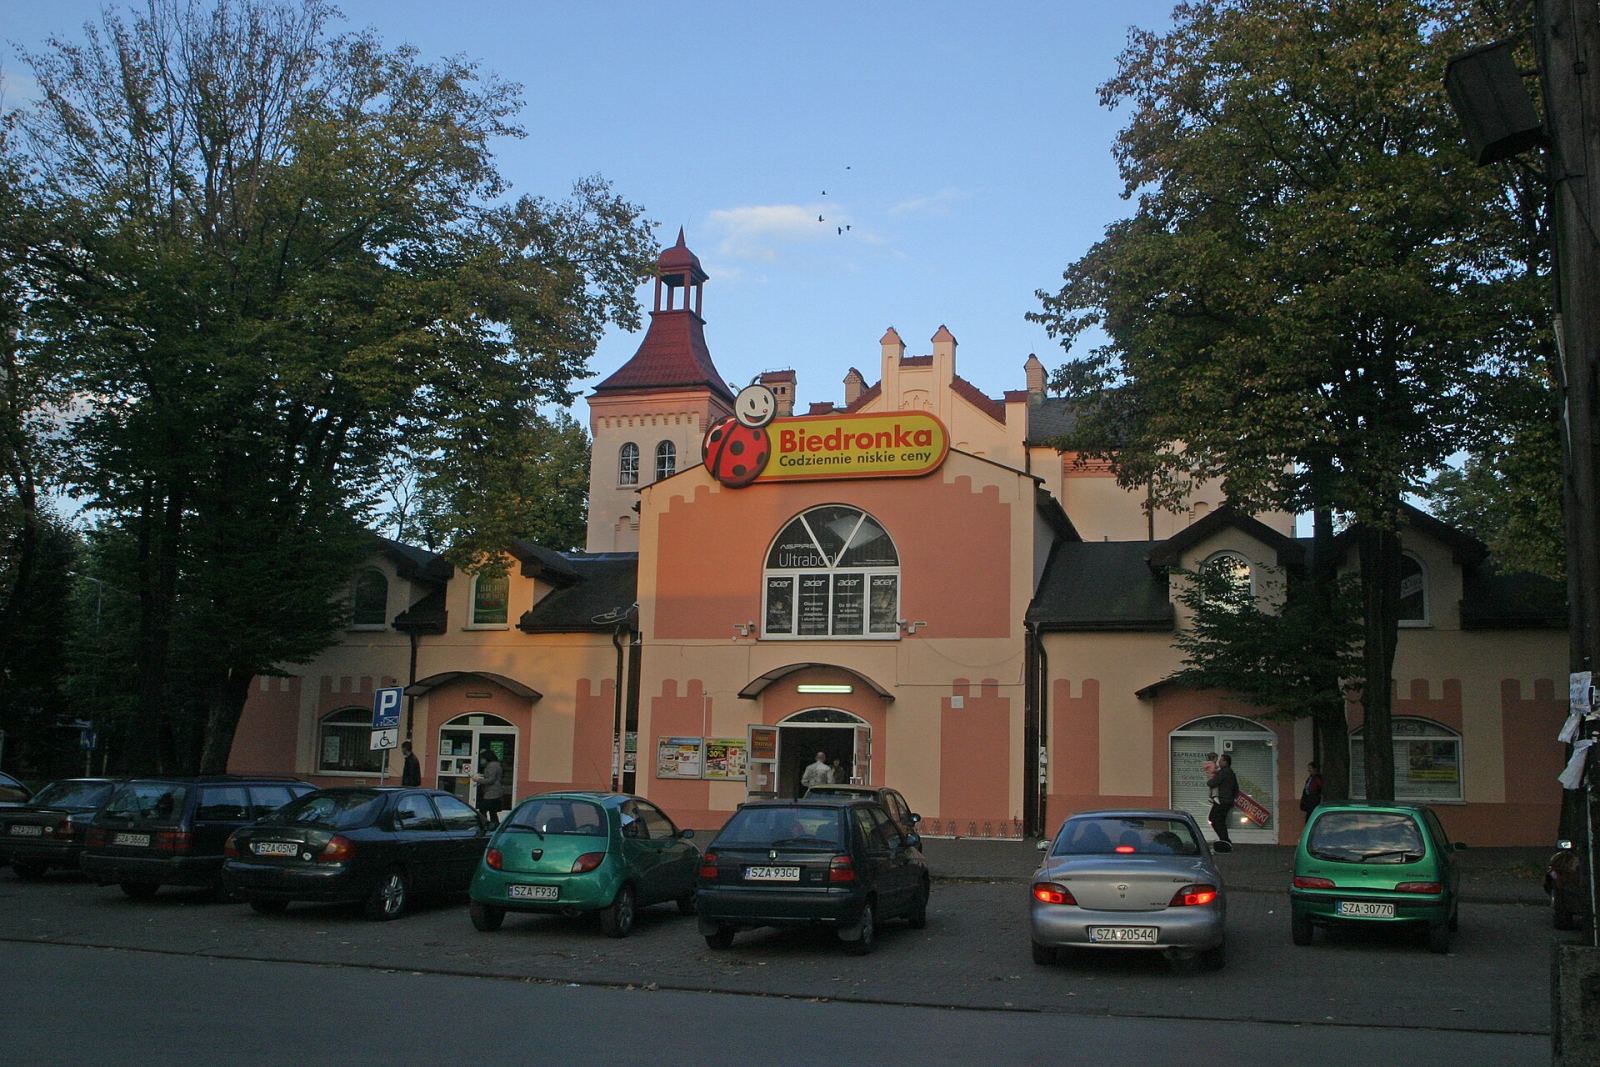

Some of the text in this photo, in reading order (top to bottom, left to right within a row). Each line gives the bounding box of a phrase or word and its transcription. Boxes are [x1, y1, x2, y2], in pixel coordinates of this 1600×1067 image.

[780, 425, 932, 453] Biedronka
[779, 452, 931, 467] Codziennie niskie ceny
[769, 580, 791, 588] acer
[872, 578, 895, 586] acer
[380, 690, 398, 716] P
[751, 867, 771, 877] SZA
[514, 886, 557, 898] SZA F936
[1342, 903, 1393, 915] SZA 30770
[1096, 929, 1154, 940] SZA 20544
